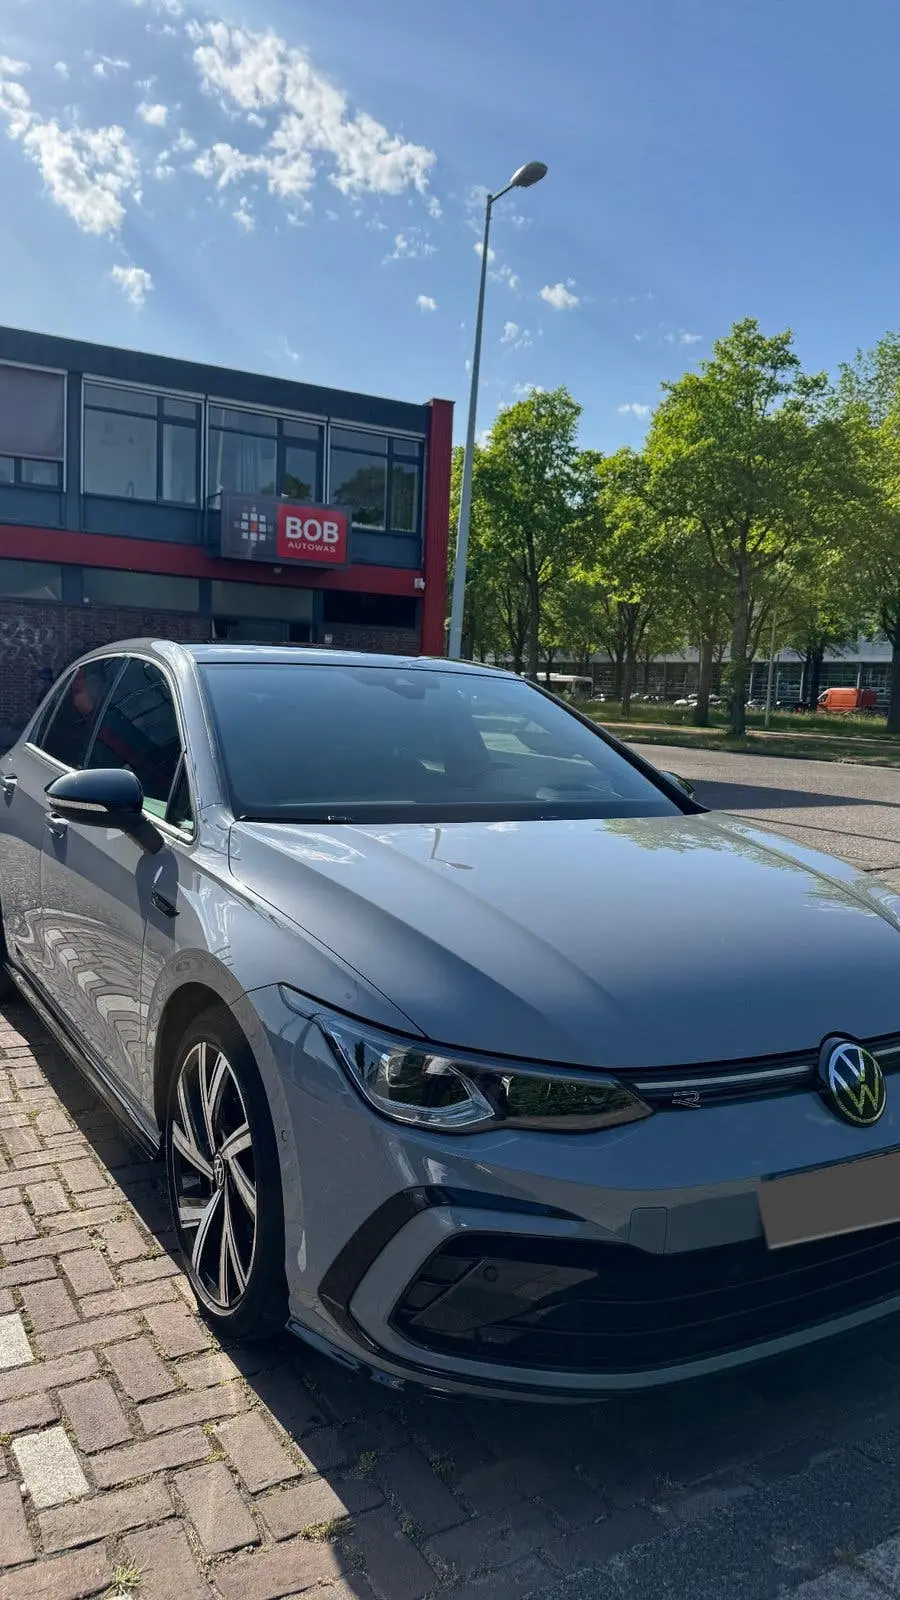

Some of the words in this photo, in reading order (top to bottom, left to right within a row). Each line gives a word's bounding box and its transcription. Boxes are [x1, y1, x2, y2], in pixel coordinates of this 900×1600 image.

[286, 516, 339, 543] BOB
[287, 541, 336, 553] AUTOWAS
[829, 1044, 884, 1122] VW
